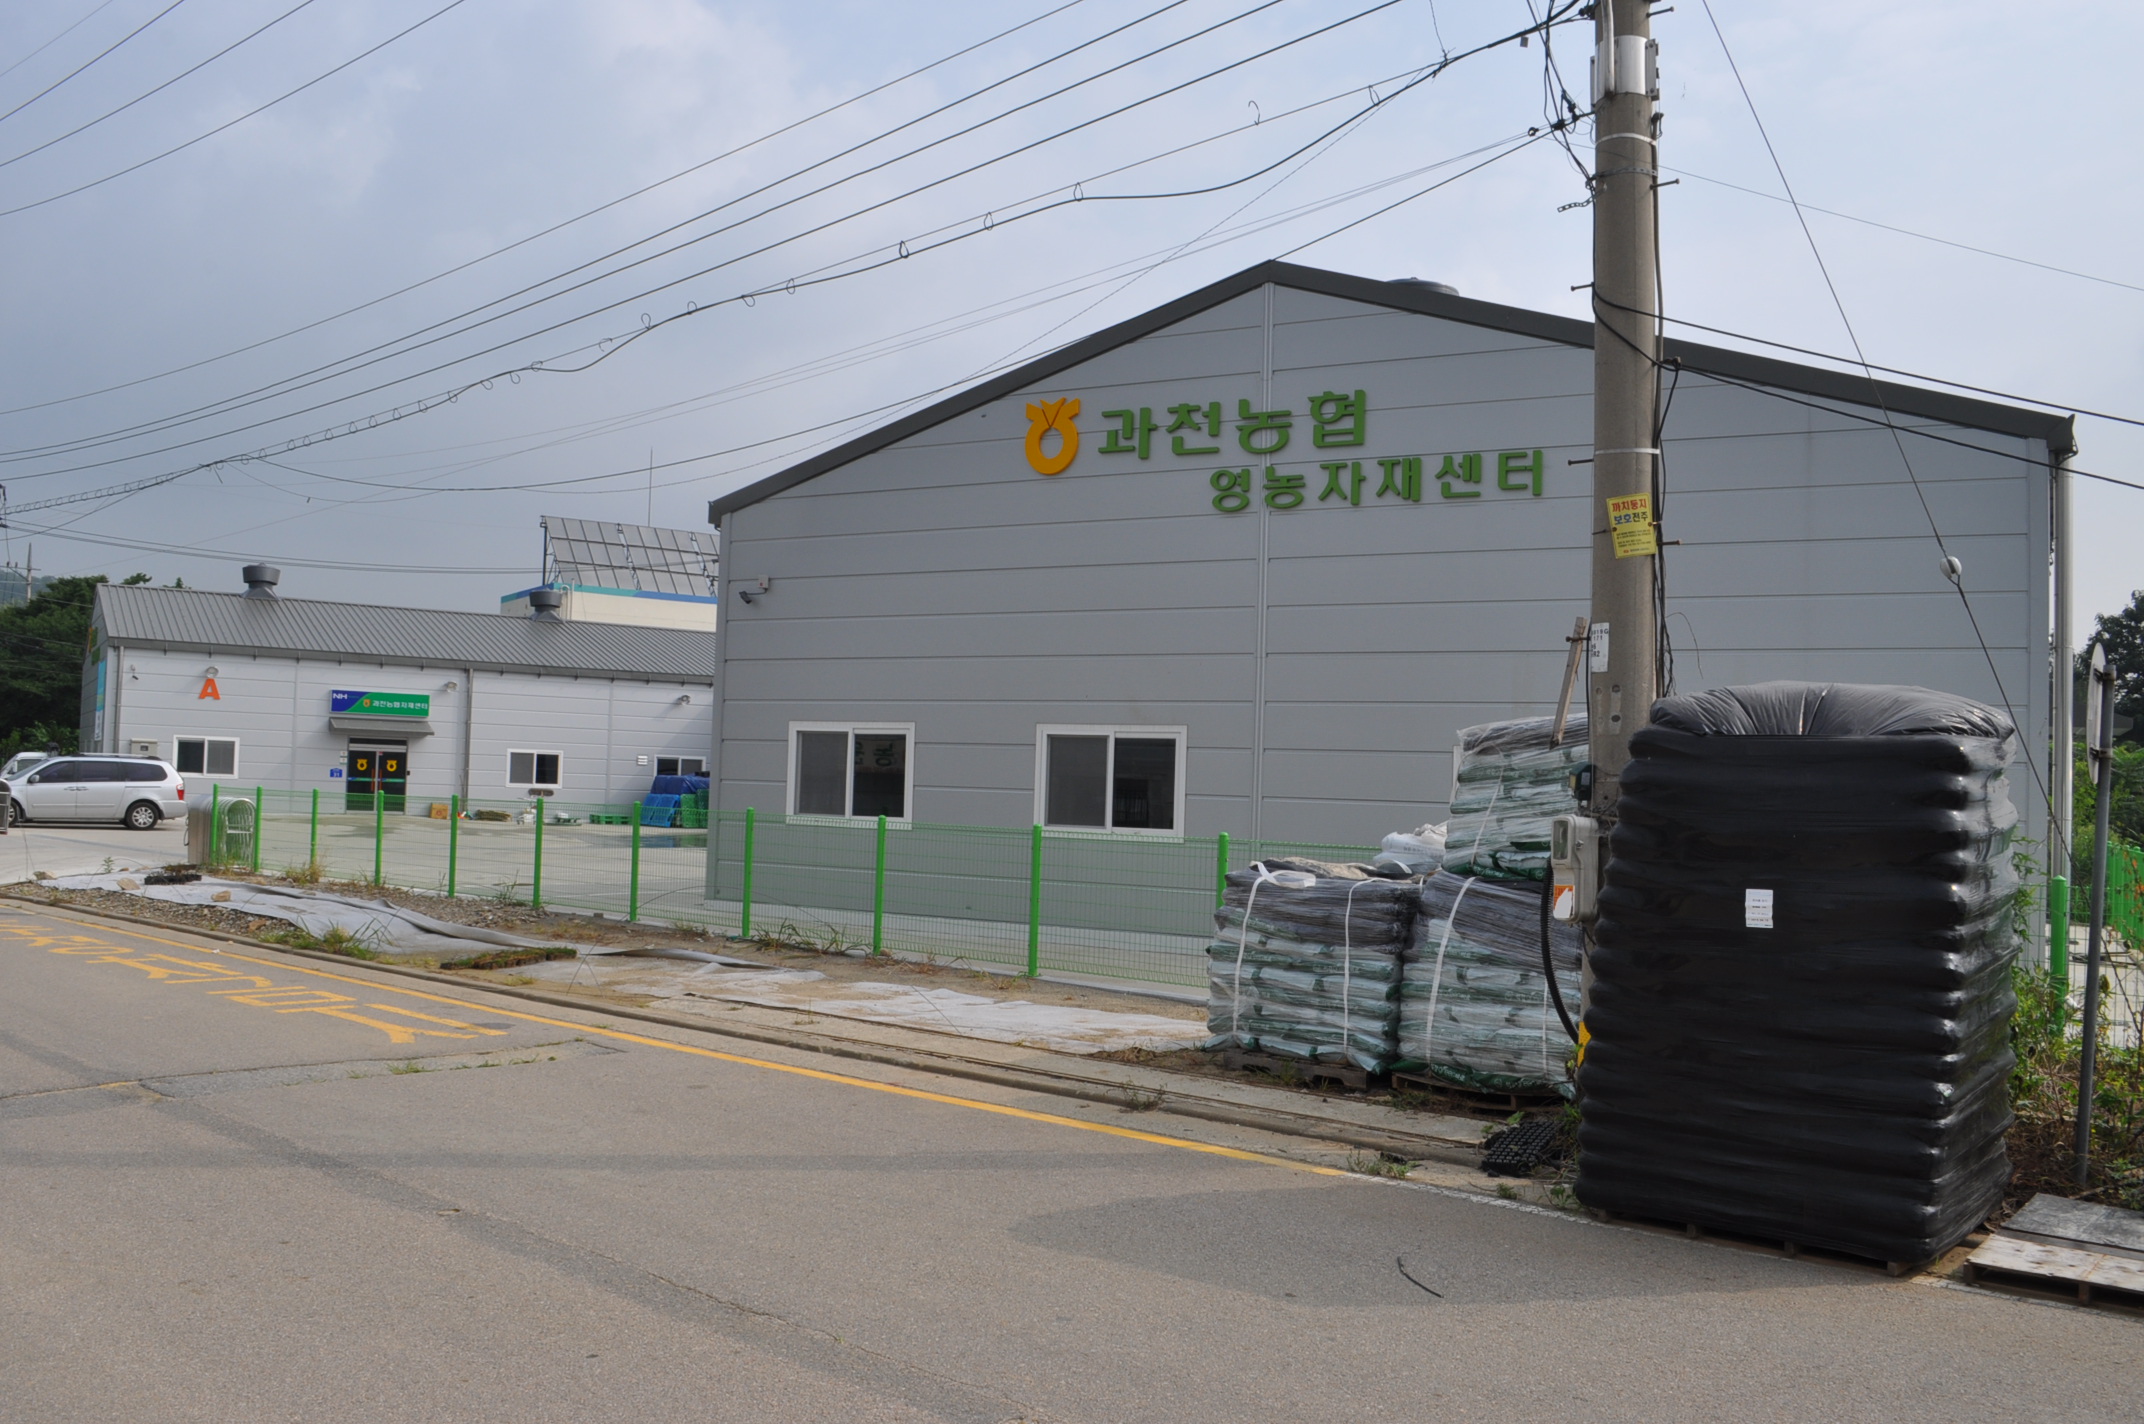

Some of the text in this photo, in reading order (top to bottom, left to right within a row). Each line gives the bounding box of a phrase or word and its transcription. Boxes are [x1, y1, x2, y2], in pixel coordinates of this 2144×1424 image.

[1098, 390, 1366, 460] 과천농협
[1210, 450, 1543, 513] 영농자재센터
[1611, 498, 1647, 512] 까치둥지
[199, 678, 221, 700] A
